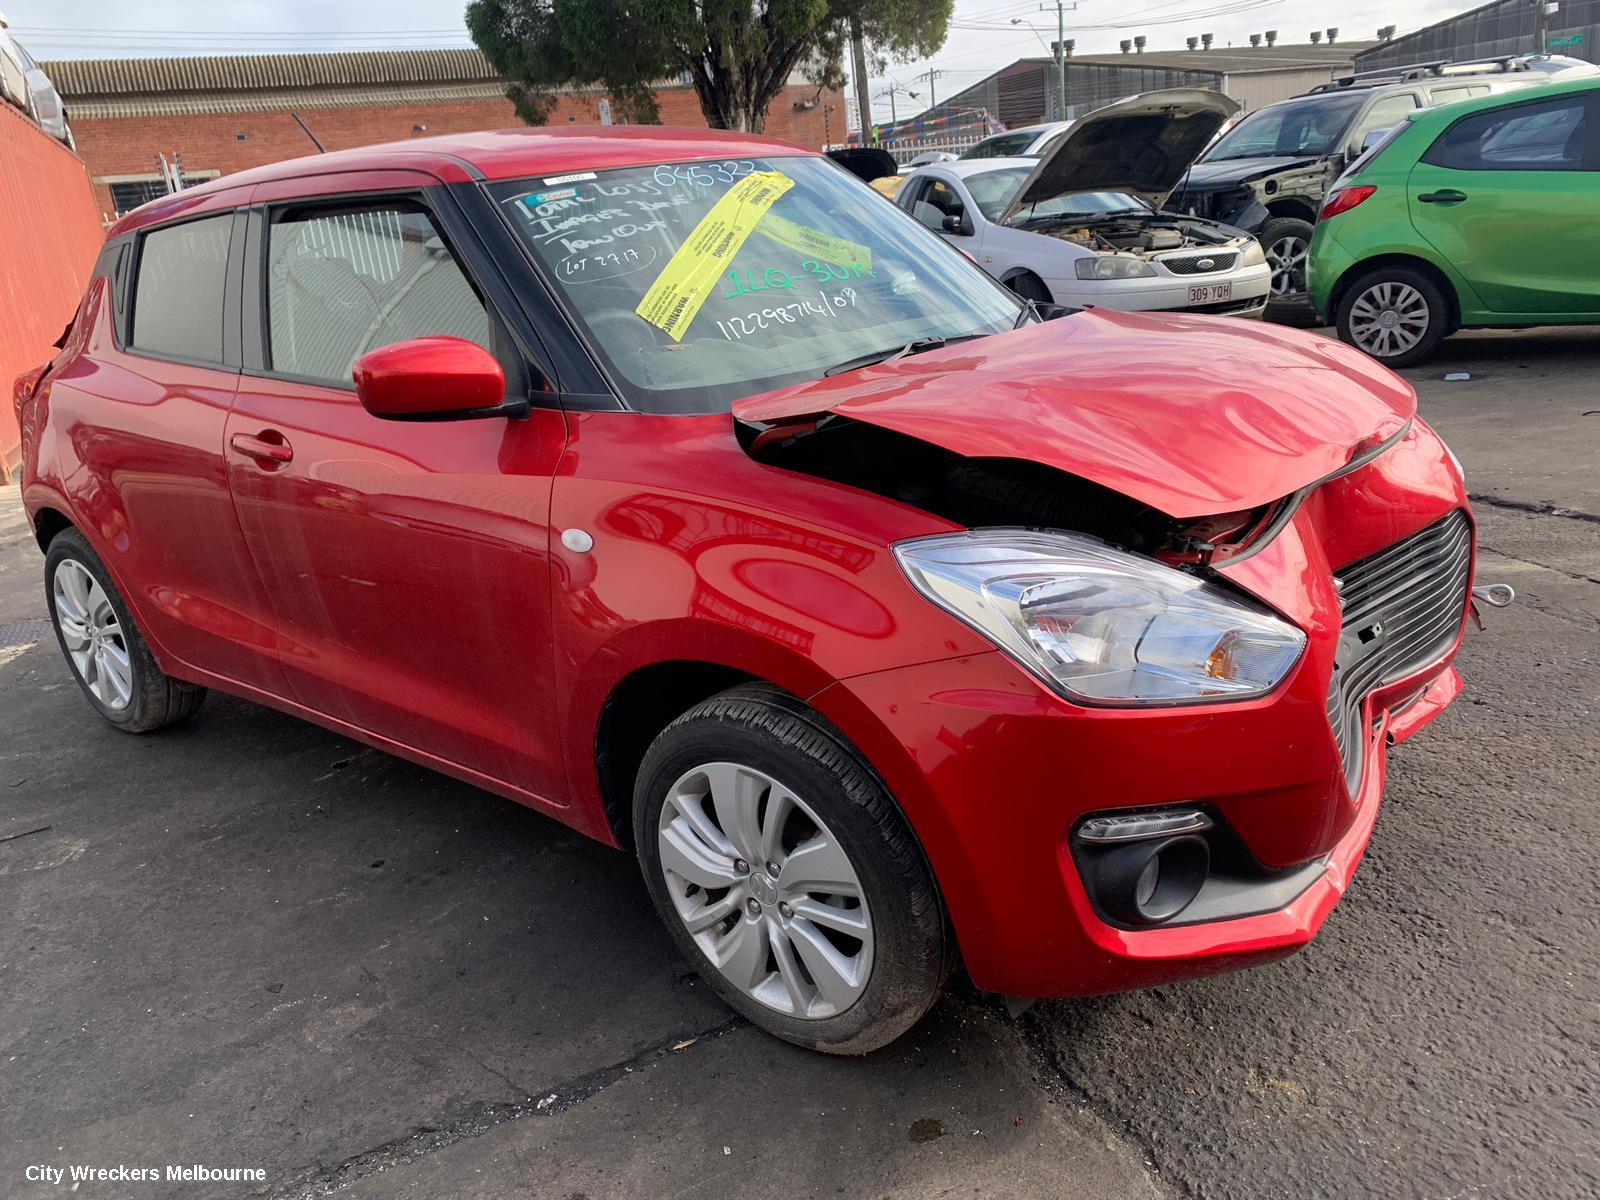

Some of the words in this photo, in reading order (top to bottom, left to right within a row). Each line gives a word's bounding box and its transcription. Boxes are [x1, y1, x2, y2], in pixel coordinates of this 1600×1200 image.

[565, 257, 588, 275] LOT
[593, 248, 640, 266] 2717
[1189, 286, 1209, 302] 309
